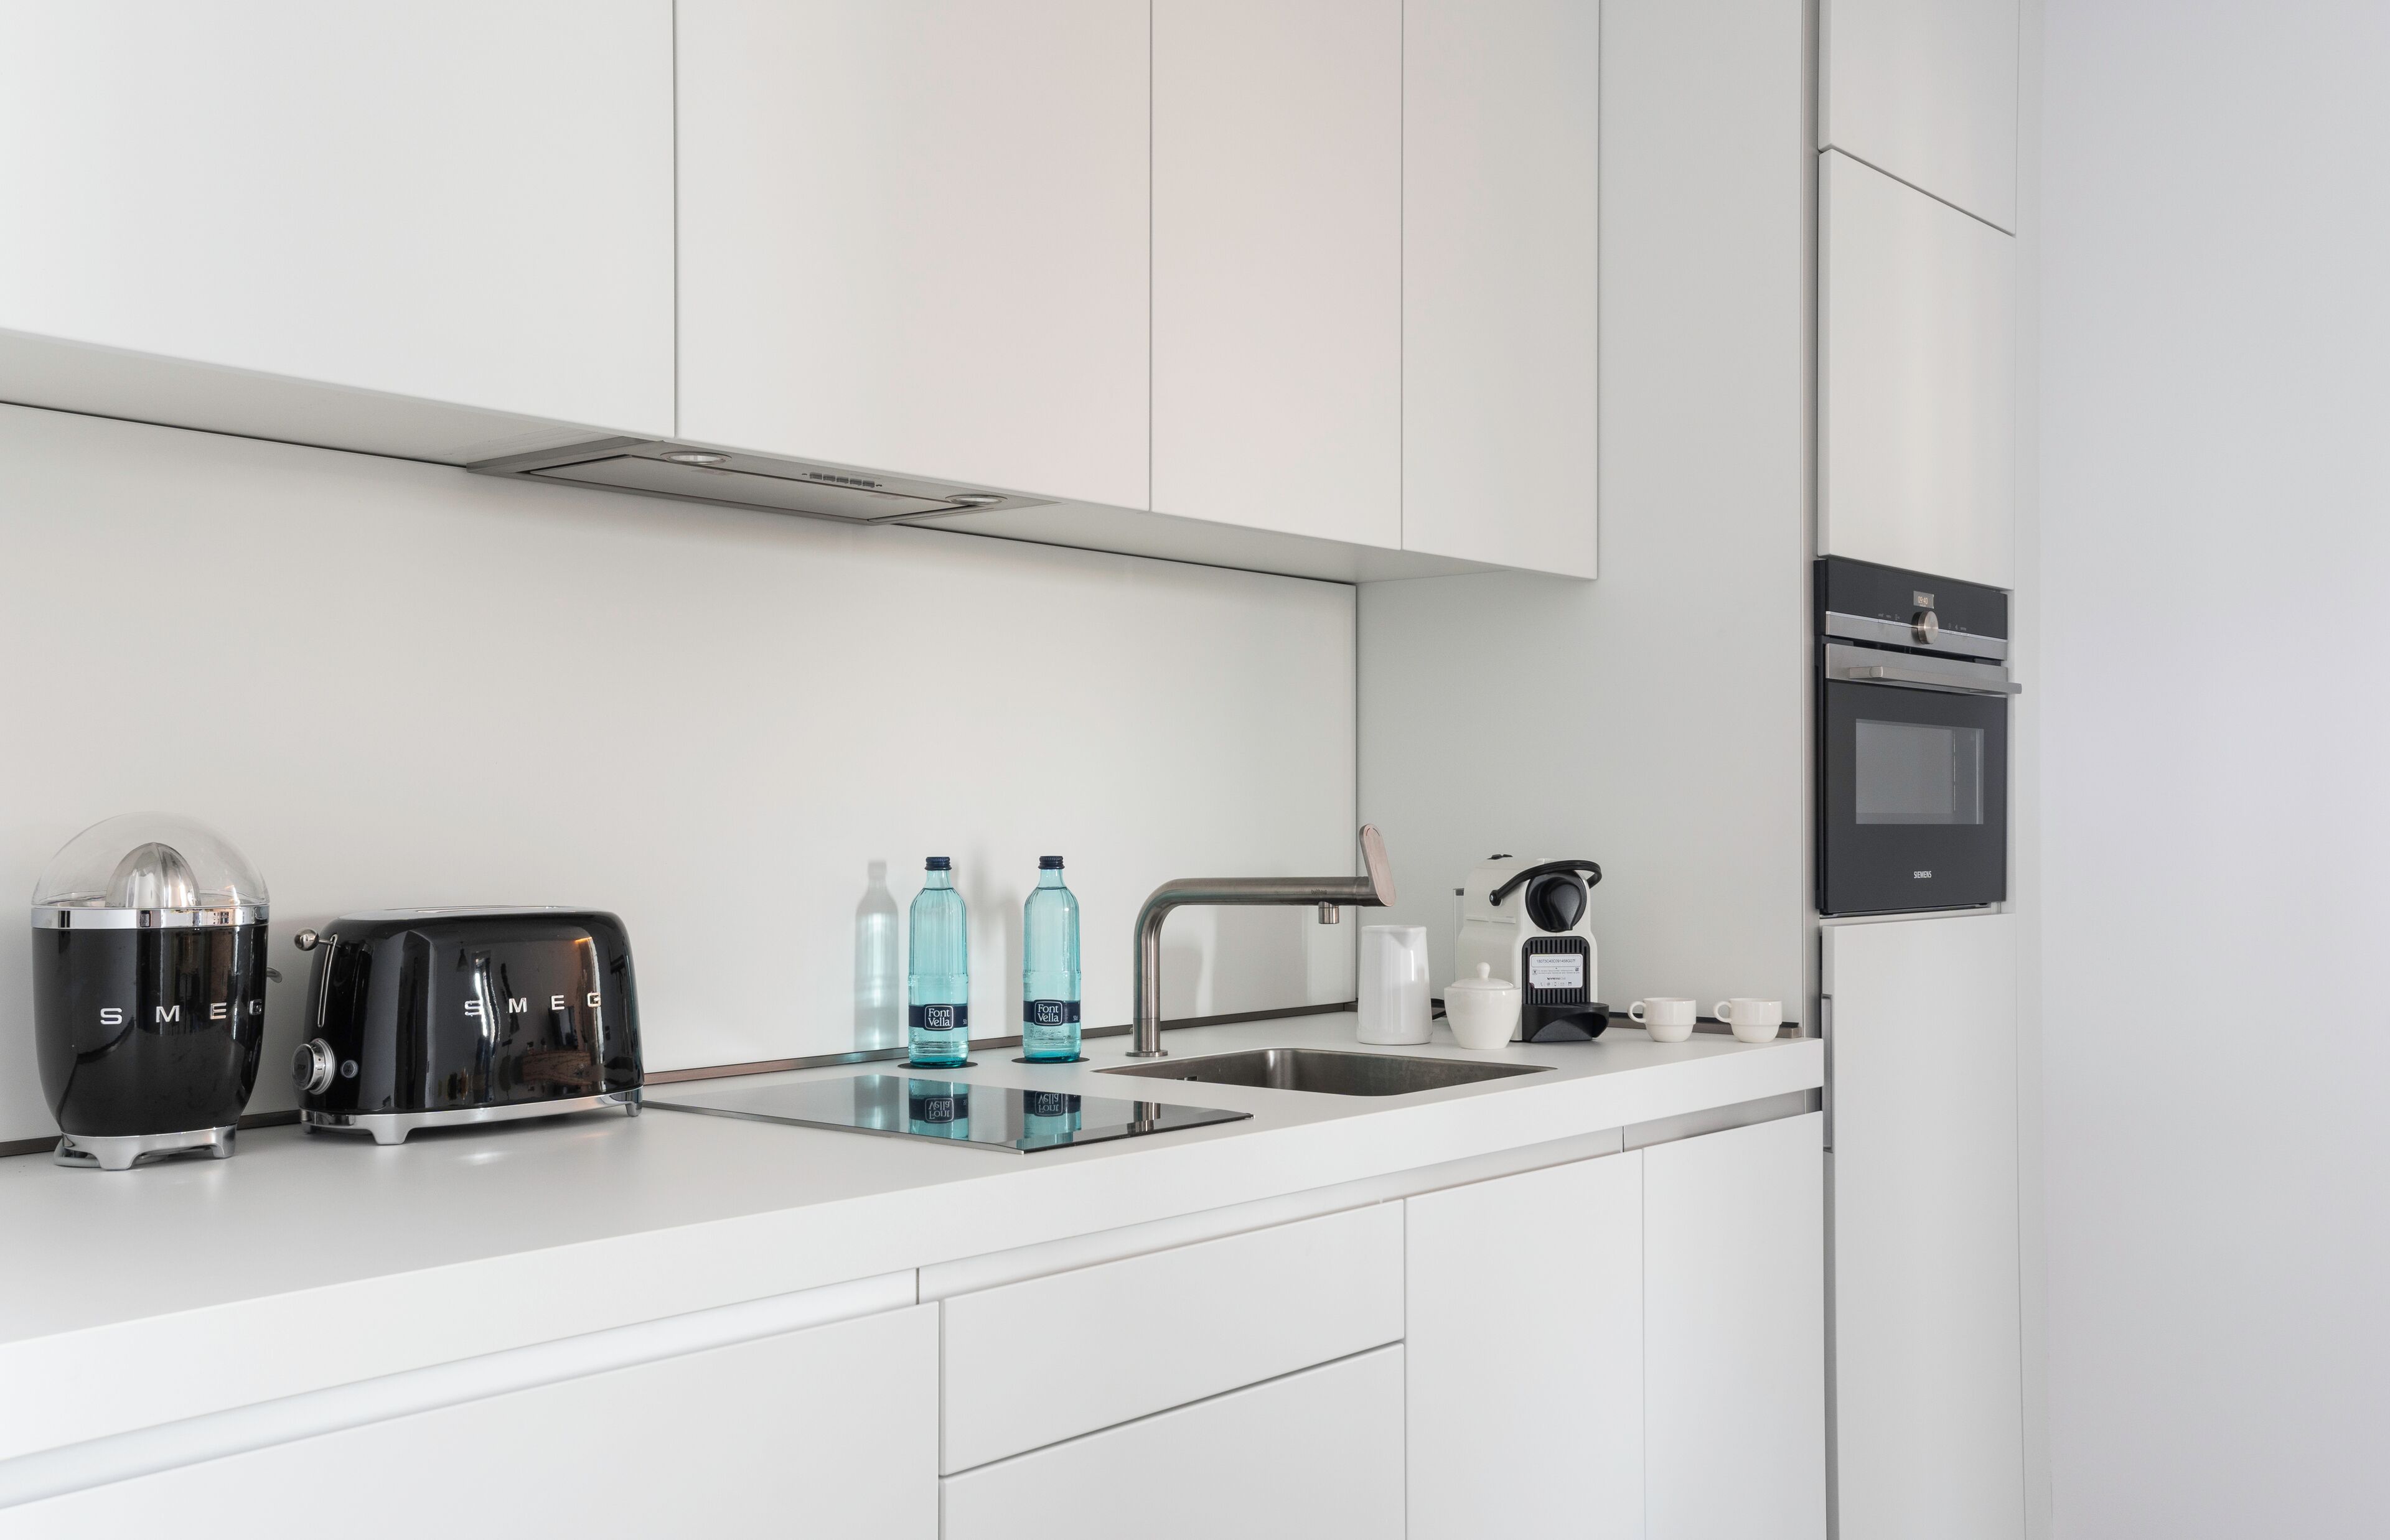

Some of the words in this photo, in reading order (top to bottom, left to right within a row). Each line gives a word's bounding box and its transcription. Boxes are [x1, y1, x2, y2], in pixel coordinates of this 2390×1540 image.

[1918, 596, 1928, 604] 09:40
[1914, 870, 1932, 879] SIEMENS
[464, 992, 601, 1017] SMEG
[1038, 1004, 1059, 1014] Font
[100, 999, 263, 1025] SMEG
[928, 1008, 950, 1017] Font
[928, 1017, 950, 1027] Vella
[1038, 1013, 1059, 1022] Vella
